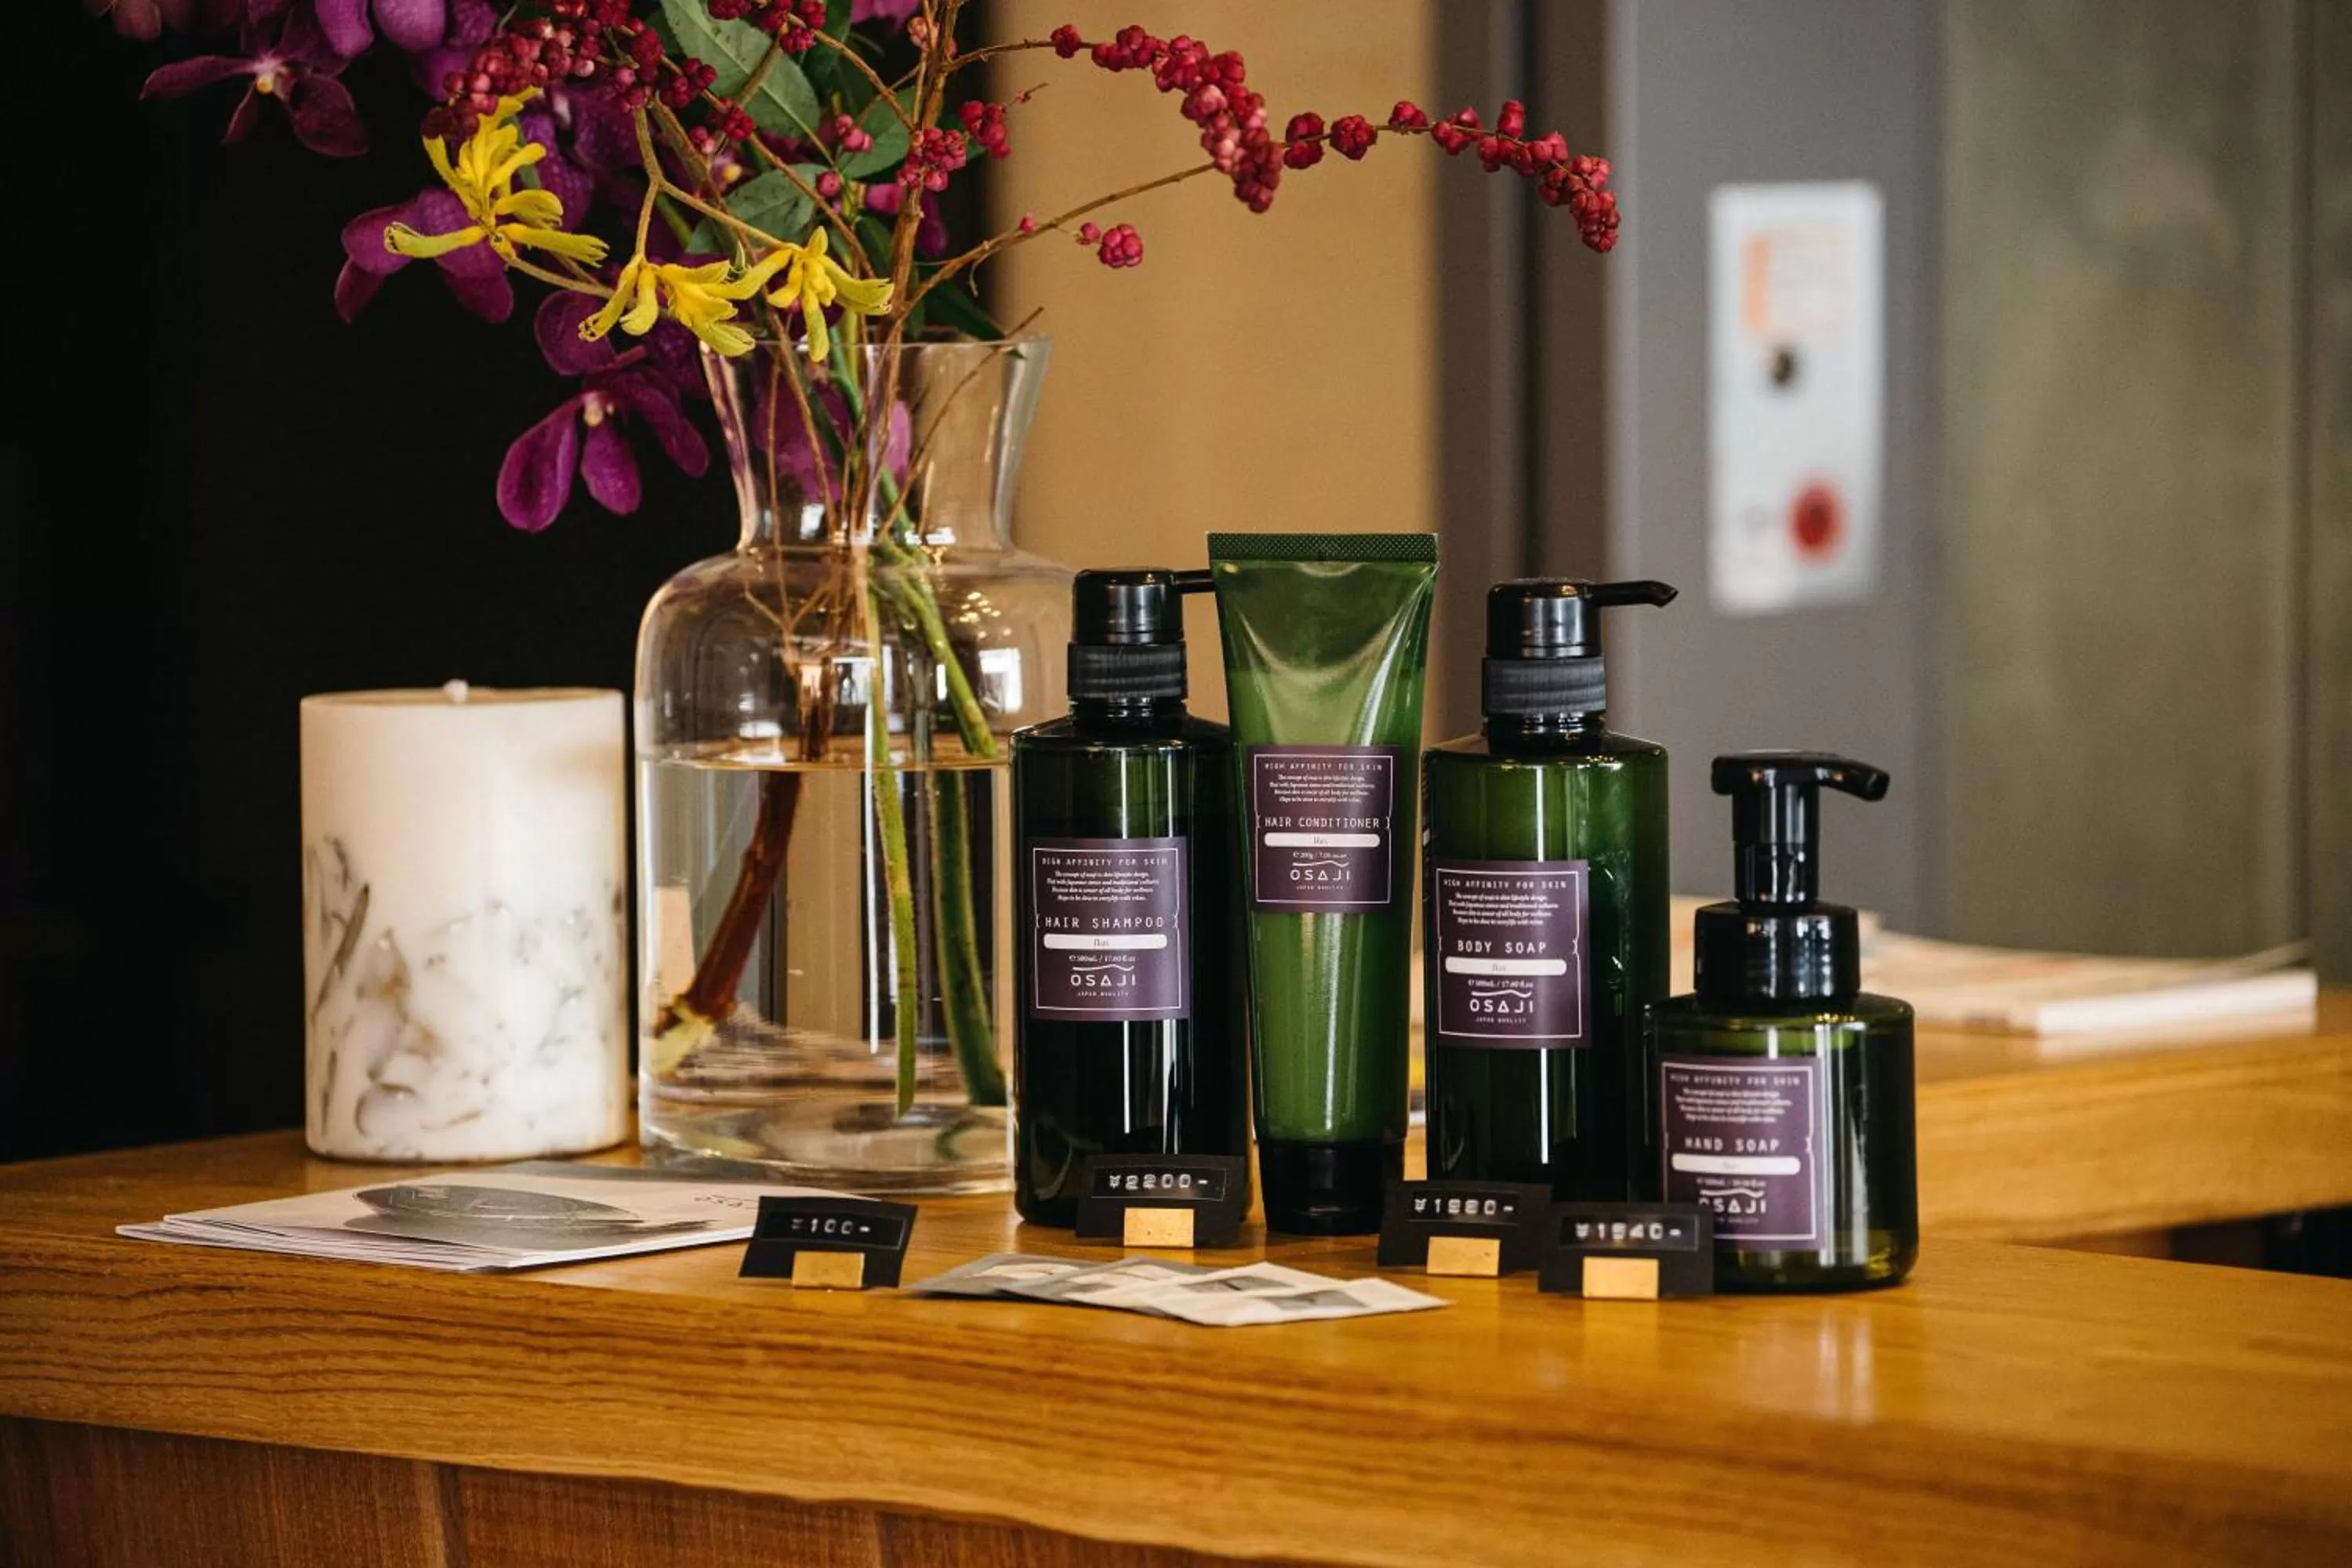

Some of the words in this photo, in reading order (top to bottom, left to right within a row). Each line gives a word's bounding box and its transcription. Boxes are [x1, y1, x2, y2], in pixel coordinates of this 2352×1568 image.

[1264, 816, 1292, 828] HAIR
[1299, 817, 1380, 829] CONDITIONER
[1290, 869, 1350, 881] OSAJI
[1045, 916, 1080, 928] HAIR
[1091, 916, 1165, 929] SHAMPOO
[1457, 939, 1492, 953] BODY
[1504, 942, 1548, 954] SOAP
[1070, 975, 1136, 987] OSAJI
[1469, 999, 1534, 1014] OSAJI
[1685, 1137, 1724, 1152] HAND
[1735, 1138, 1780, 1152] SOAP
